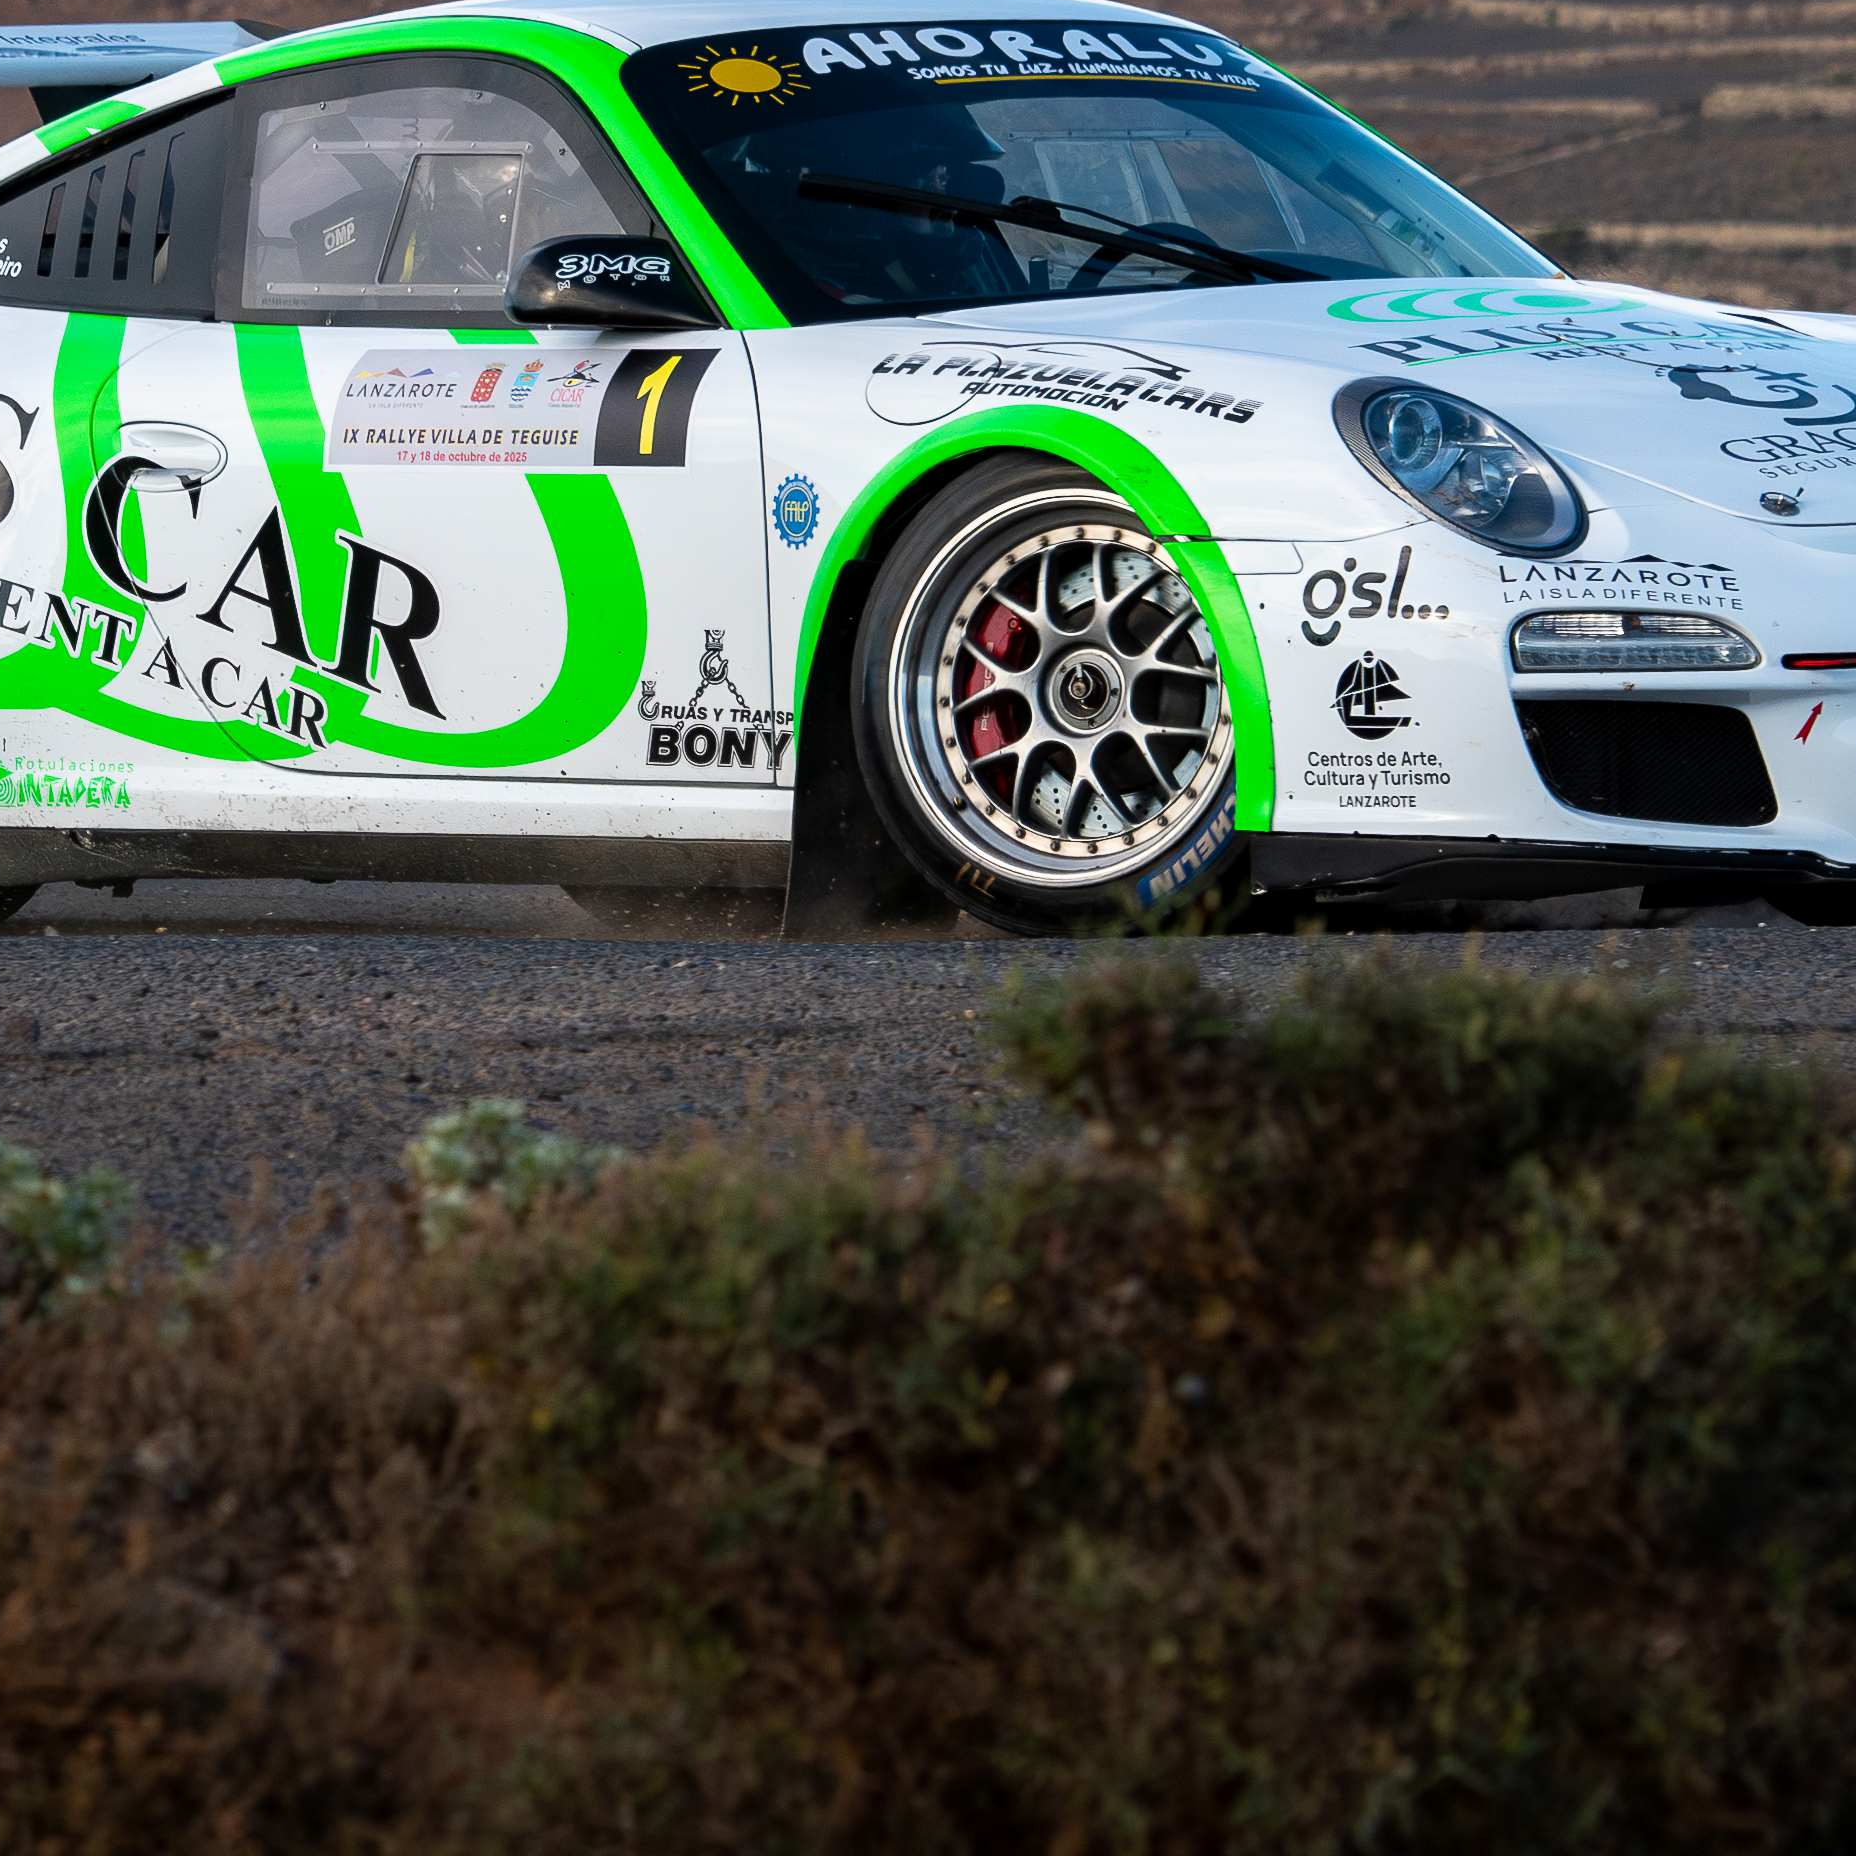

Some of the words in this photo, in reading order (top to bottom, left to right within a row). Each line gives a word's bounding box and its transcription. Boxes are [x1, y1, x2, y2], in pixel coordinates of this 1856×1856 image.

[907, 64, 977, 80] SOMOS
[980, 64, 1009, 75] TU
[1068, 61, 1182, 78] ILUMINAMOS
[1185, 68, 1212, 81] TU
[1216, 72, 1261, 87] VIDA
[324, 221, 355, 250] OMP
[555, 253, 671, 279] 3MG
[1348, 320, 1616, 365] PLUS
[1530, 342, 1654, 366] RENT
[872, 353, 932, 375] LA
[346, 383, 457, 397] LANZAROTE
[960, 380, 1130, 412] AUTOMOCIÓN
[635, 355, 683, 455] 1
[343, 428, 360, 444] IX
[366, 428, 426, 444] RALLYE
[431, 429, 477, 445] VILLA
[481, 429, 503, 445] DE
[511, 429, 579, 445] TEGUISE
[397, 451, 408, 461] 17
[409, 454, 416, 464] y
[420, 451, 431, 462] 18
[433, 451, 446, 462] de
[448, 451, 487, 463] octubre
[489, 451, 501, 462] de
[503, 452, 528, 462] 2025
[81, 453, 446, 721] CAR
[1499, 564, 1741, 593] LANZAROTE
[1503, 589, 1533, 604] LA
[1539, 588, 1596, 600] ISLA
[1602, 588, 1744, 611] DIFERENTE
[141, 635, 184, 689] A
[200, 657, 332, 751] CAR
[713, 707, 724, 722] Y
[646, 723, 794, 770] BONY
[14, 756, 137, 773] Rotulaciones
[1308, 751, 1374, 767] Centros
[1377, 751, 1397, 767] de
[1401, 750, 1443, 769] Arte,
[1304, 770, 1365, 786] Cultura
[1368, 774, 1378, 790] y
[1380, 769, 1451, 786] Turismo
[1339, 795, 1417, 808] LANZAROTE
